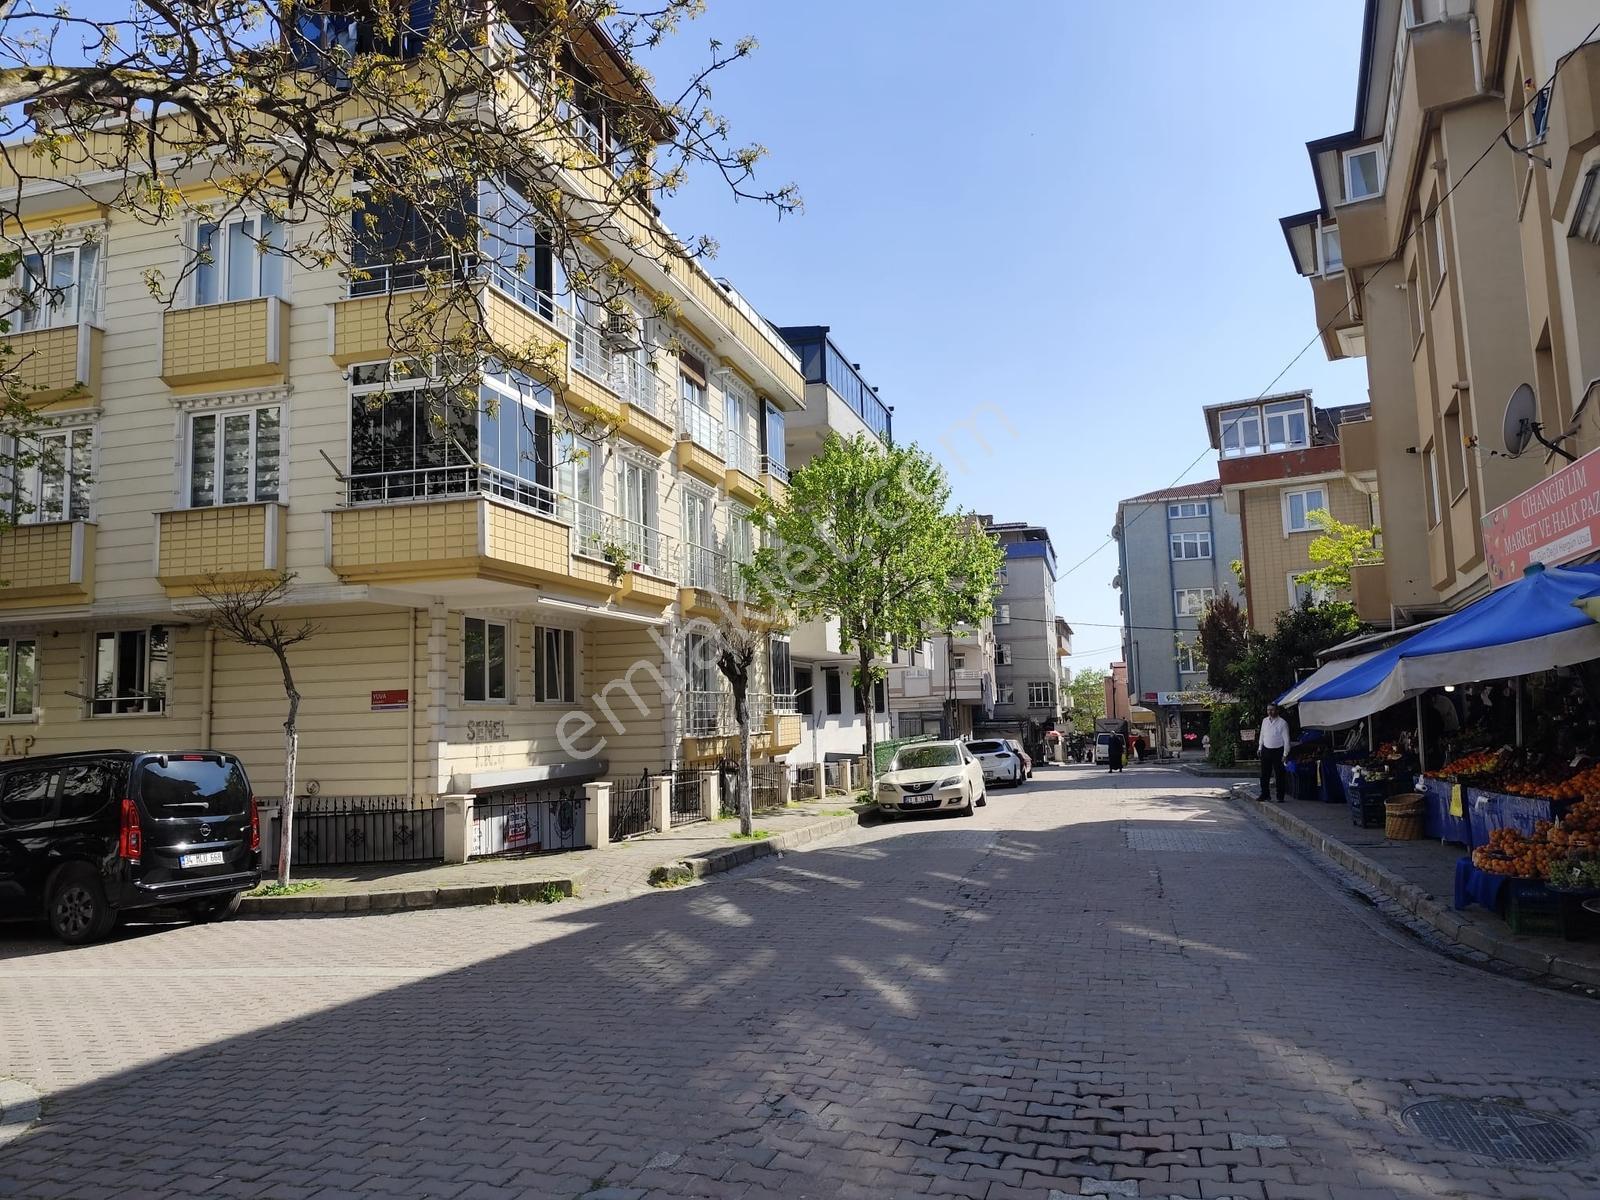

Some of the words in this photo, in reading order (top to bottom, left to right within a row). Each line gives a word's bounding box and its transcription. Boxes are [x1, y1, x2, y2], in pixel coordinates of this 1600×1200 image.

[1504, 523, 1537, 555] MARKET
[1538, 516, 1552, 538] VE
[1552, 502, 1580, 534] HALK
